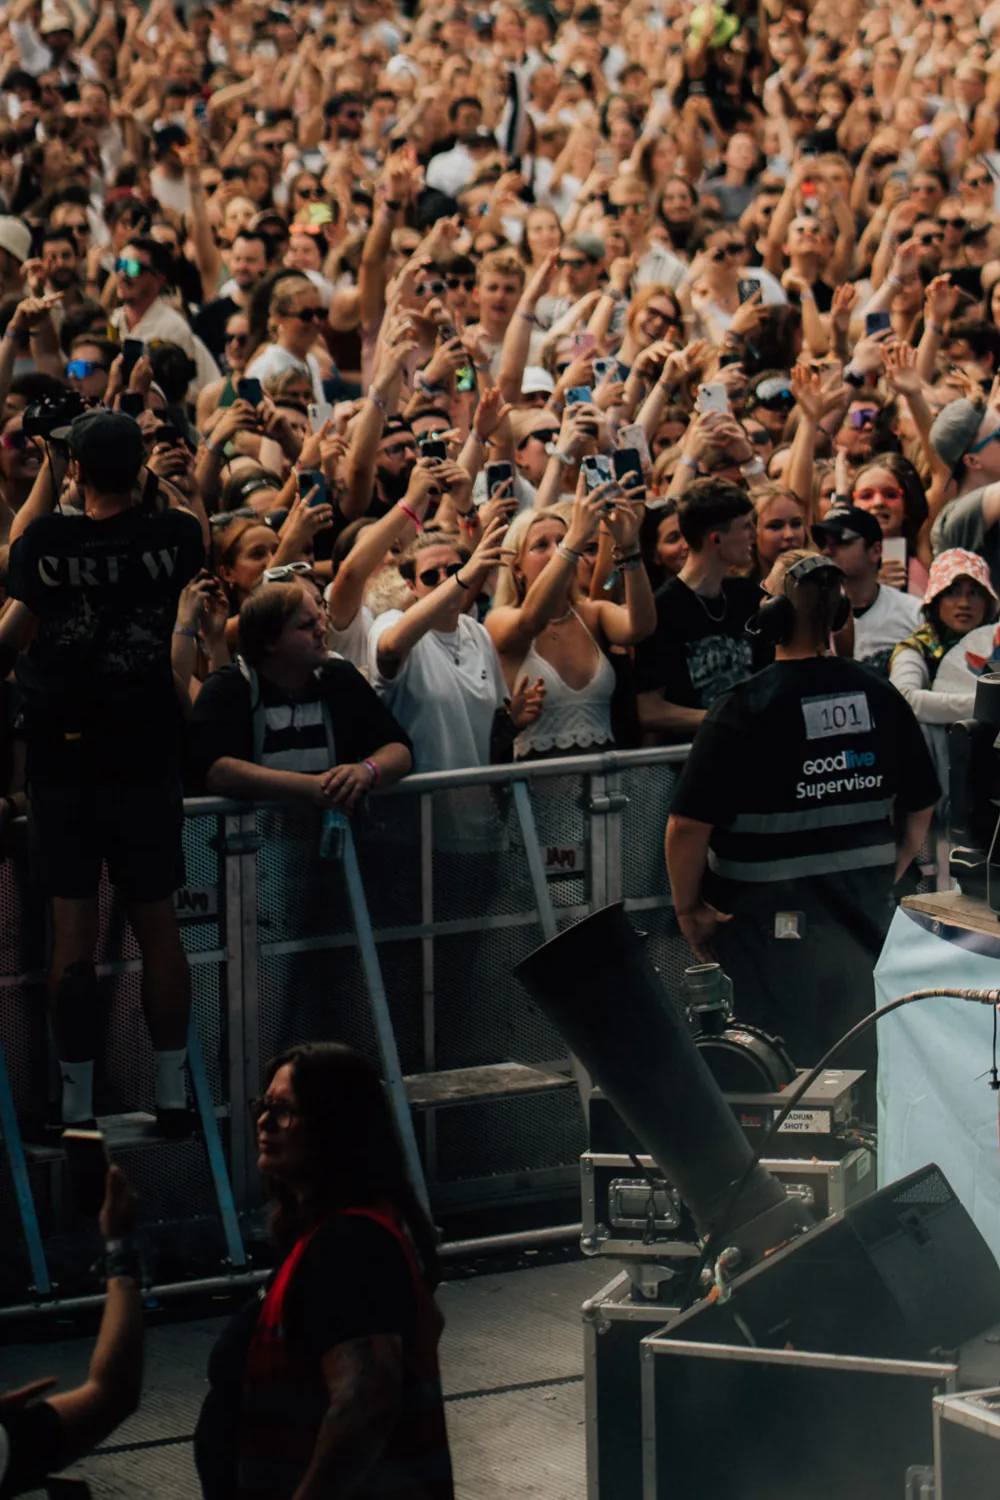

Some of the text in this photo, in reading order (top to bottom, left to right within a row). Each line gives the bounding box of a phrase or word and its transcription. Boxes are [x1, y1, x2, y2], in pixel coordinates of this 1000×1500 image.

[821, 703, 862, 731] 101
[796, 773, 883, 800] Supervisor
[786, 1113, 813, 1121] ADIUM
[783, 1122, 803, 1131] SHOT
